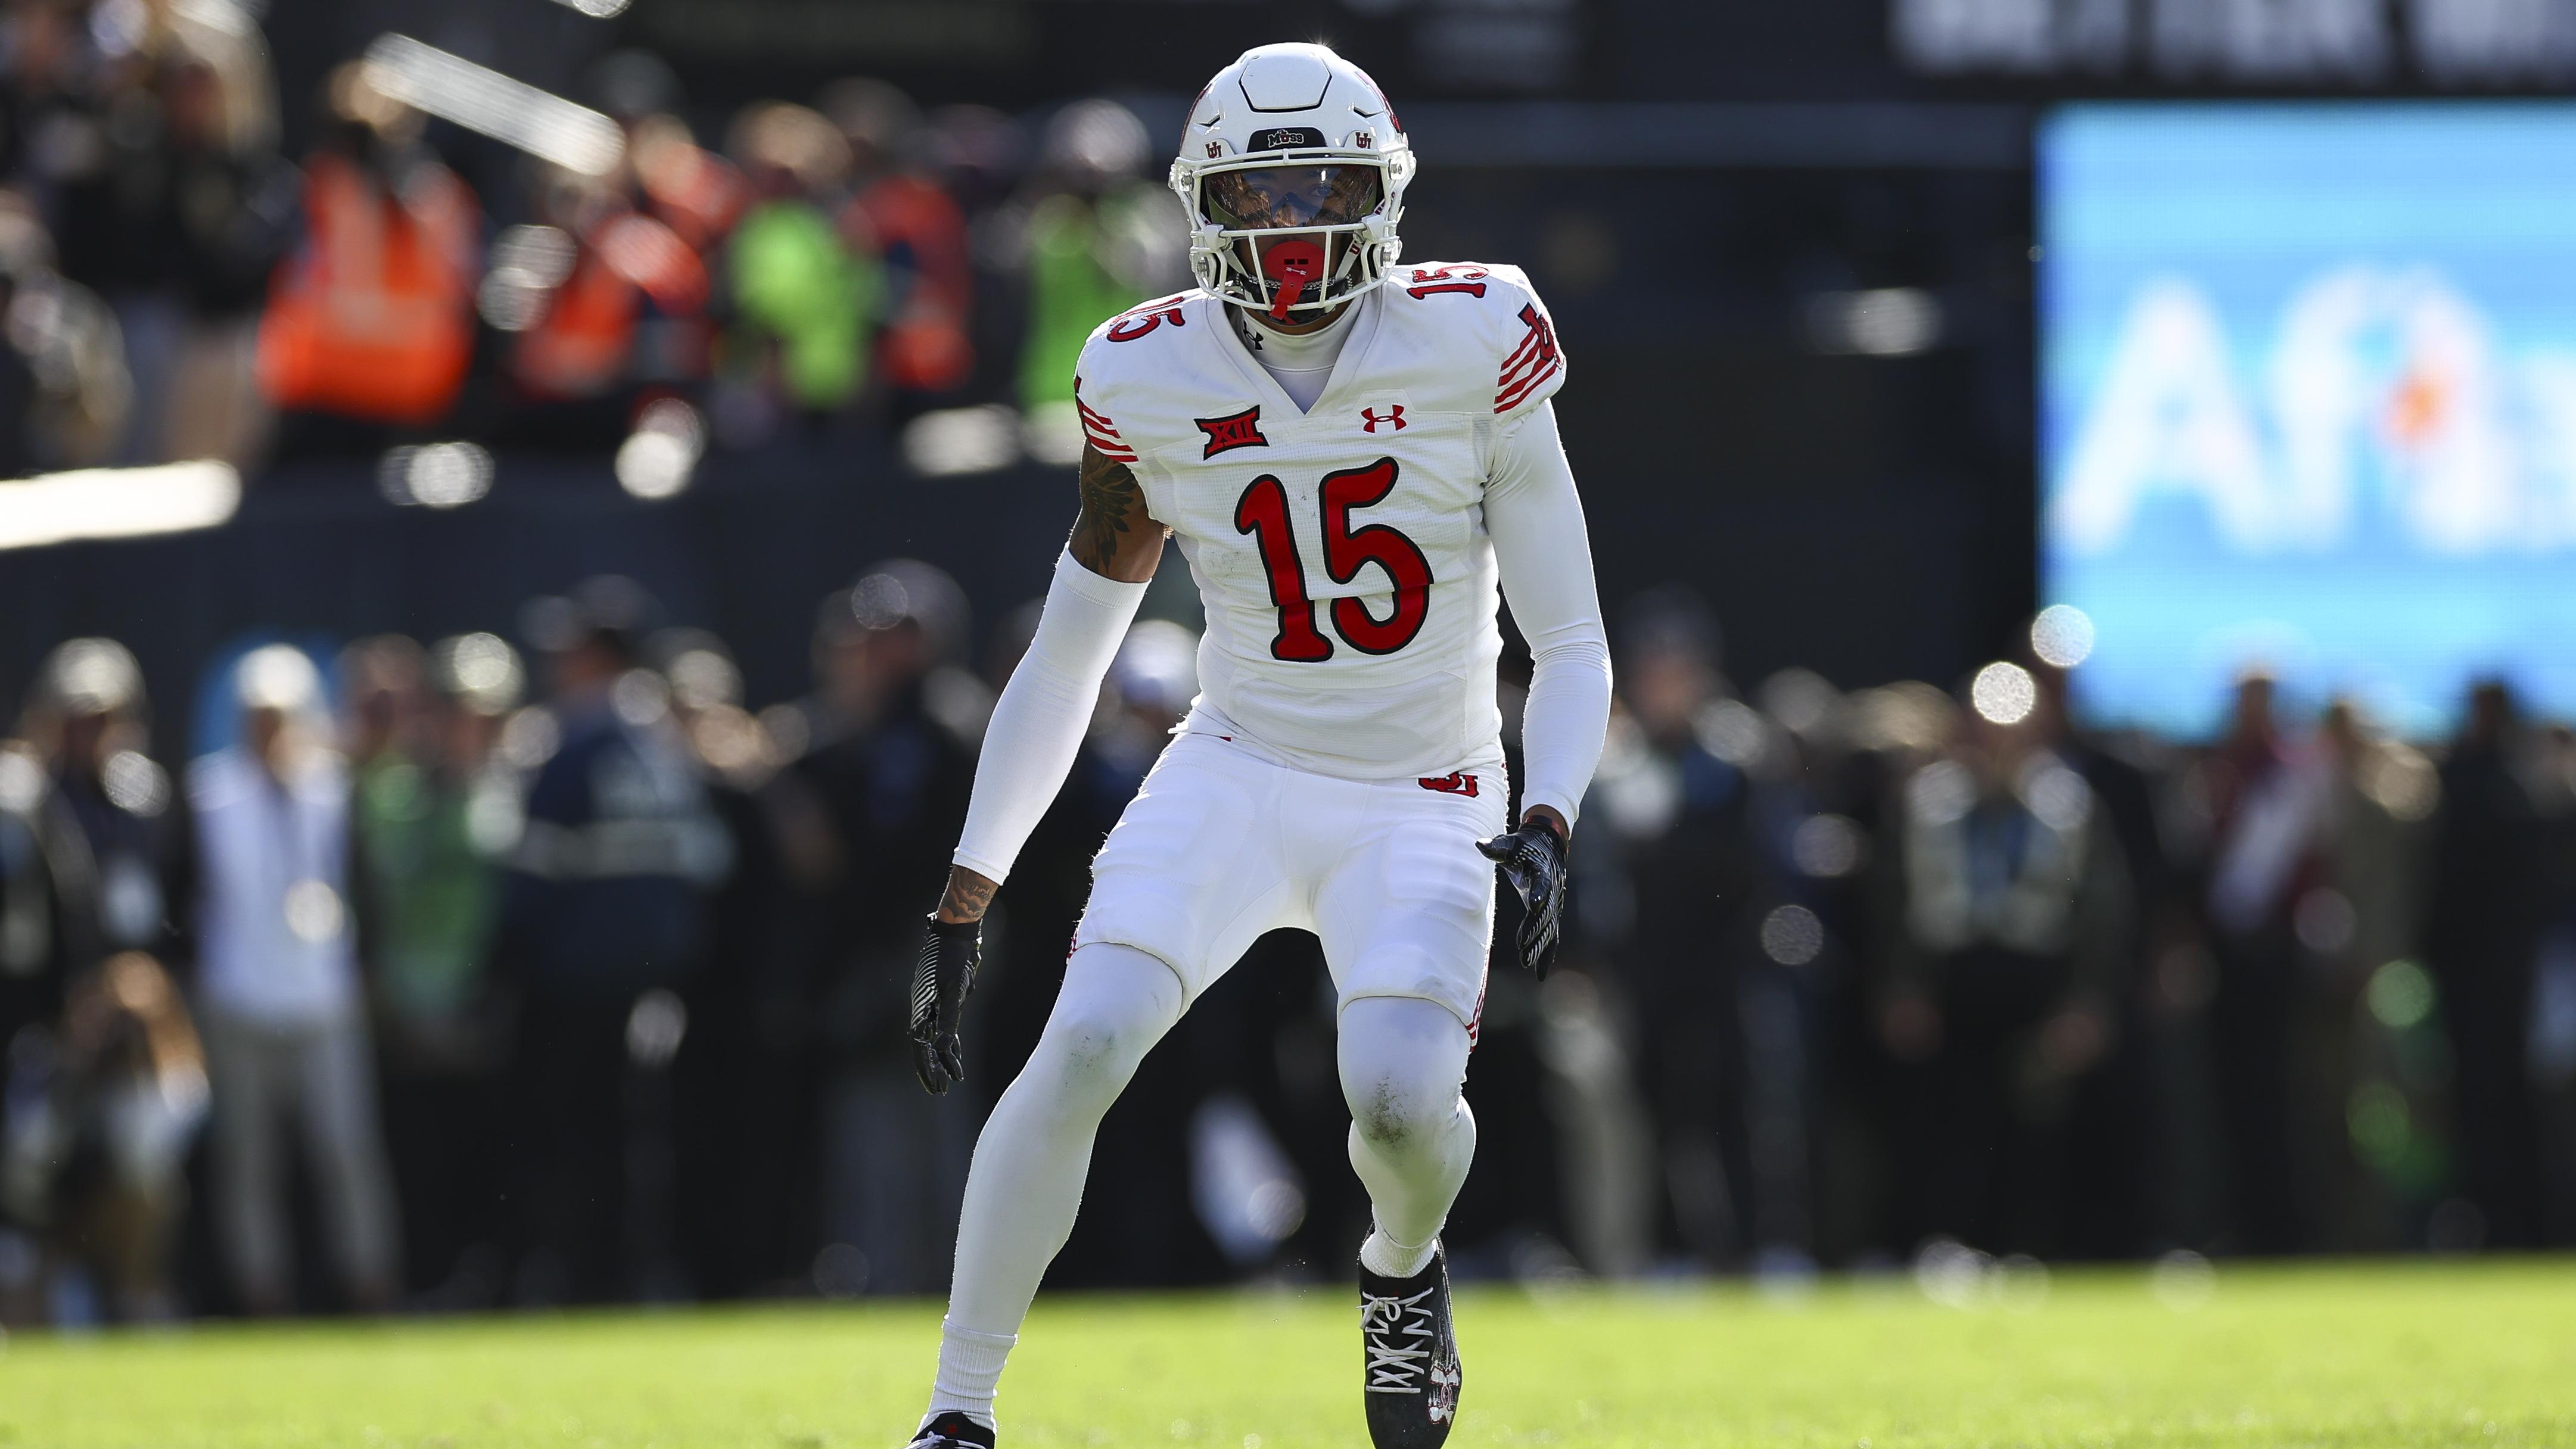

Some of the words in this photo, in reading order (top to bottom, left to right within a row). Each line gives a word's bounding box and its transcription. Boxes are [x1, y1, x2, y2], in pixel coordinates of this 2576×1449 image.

[1406, 265, 1489, 300] 15
[1197, 407, 1266, 457] XII
[1234, 456, 1434, 663] 15
